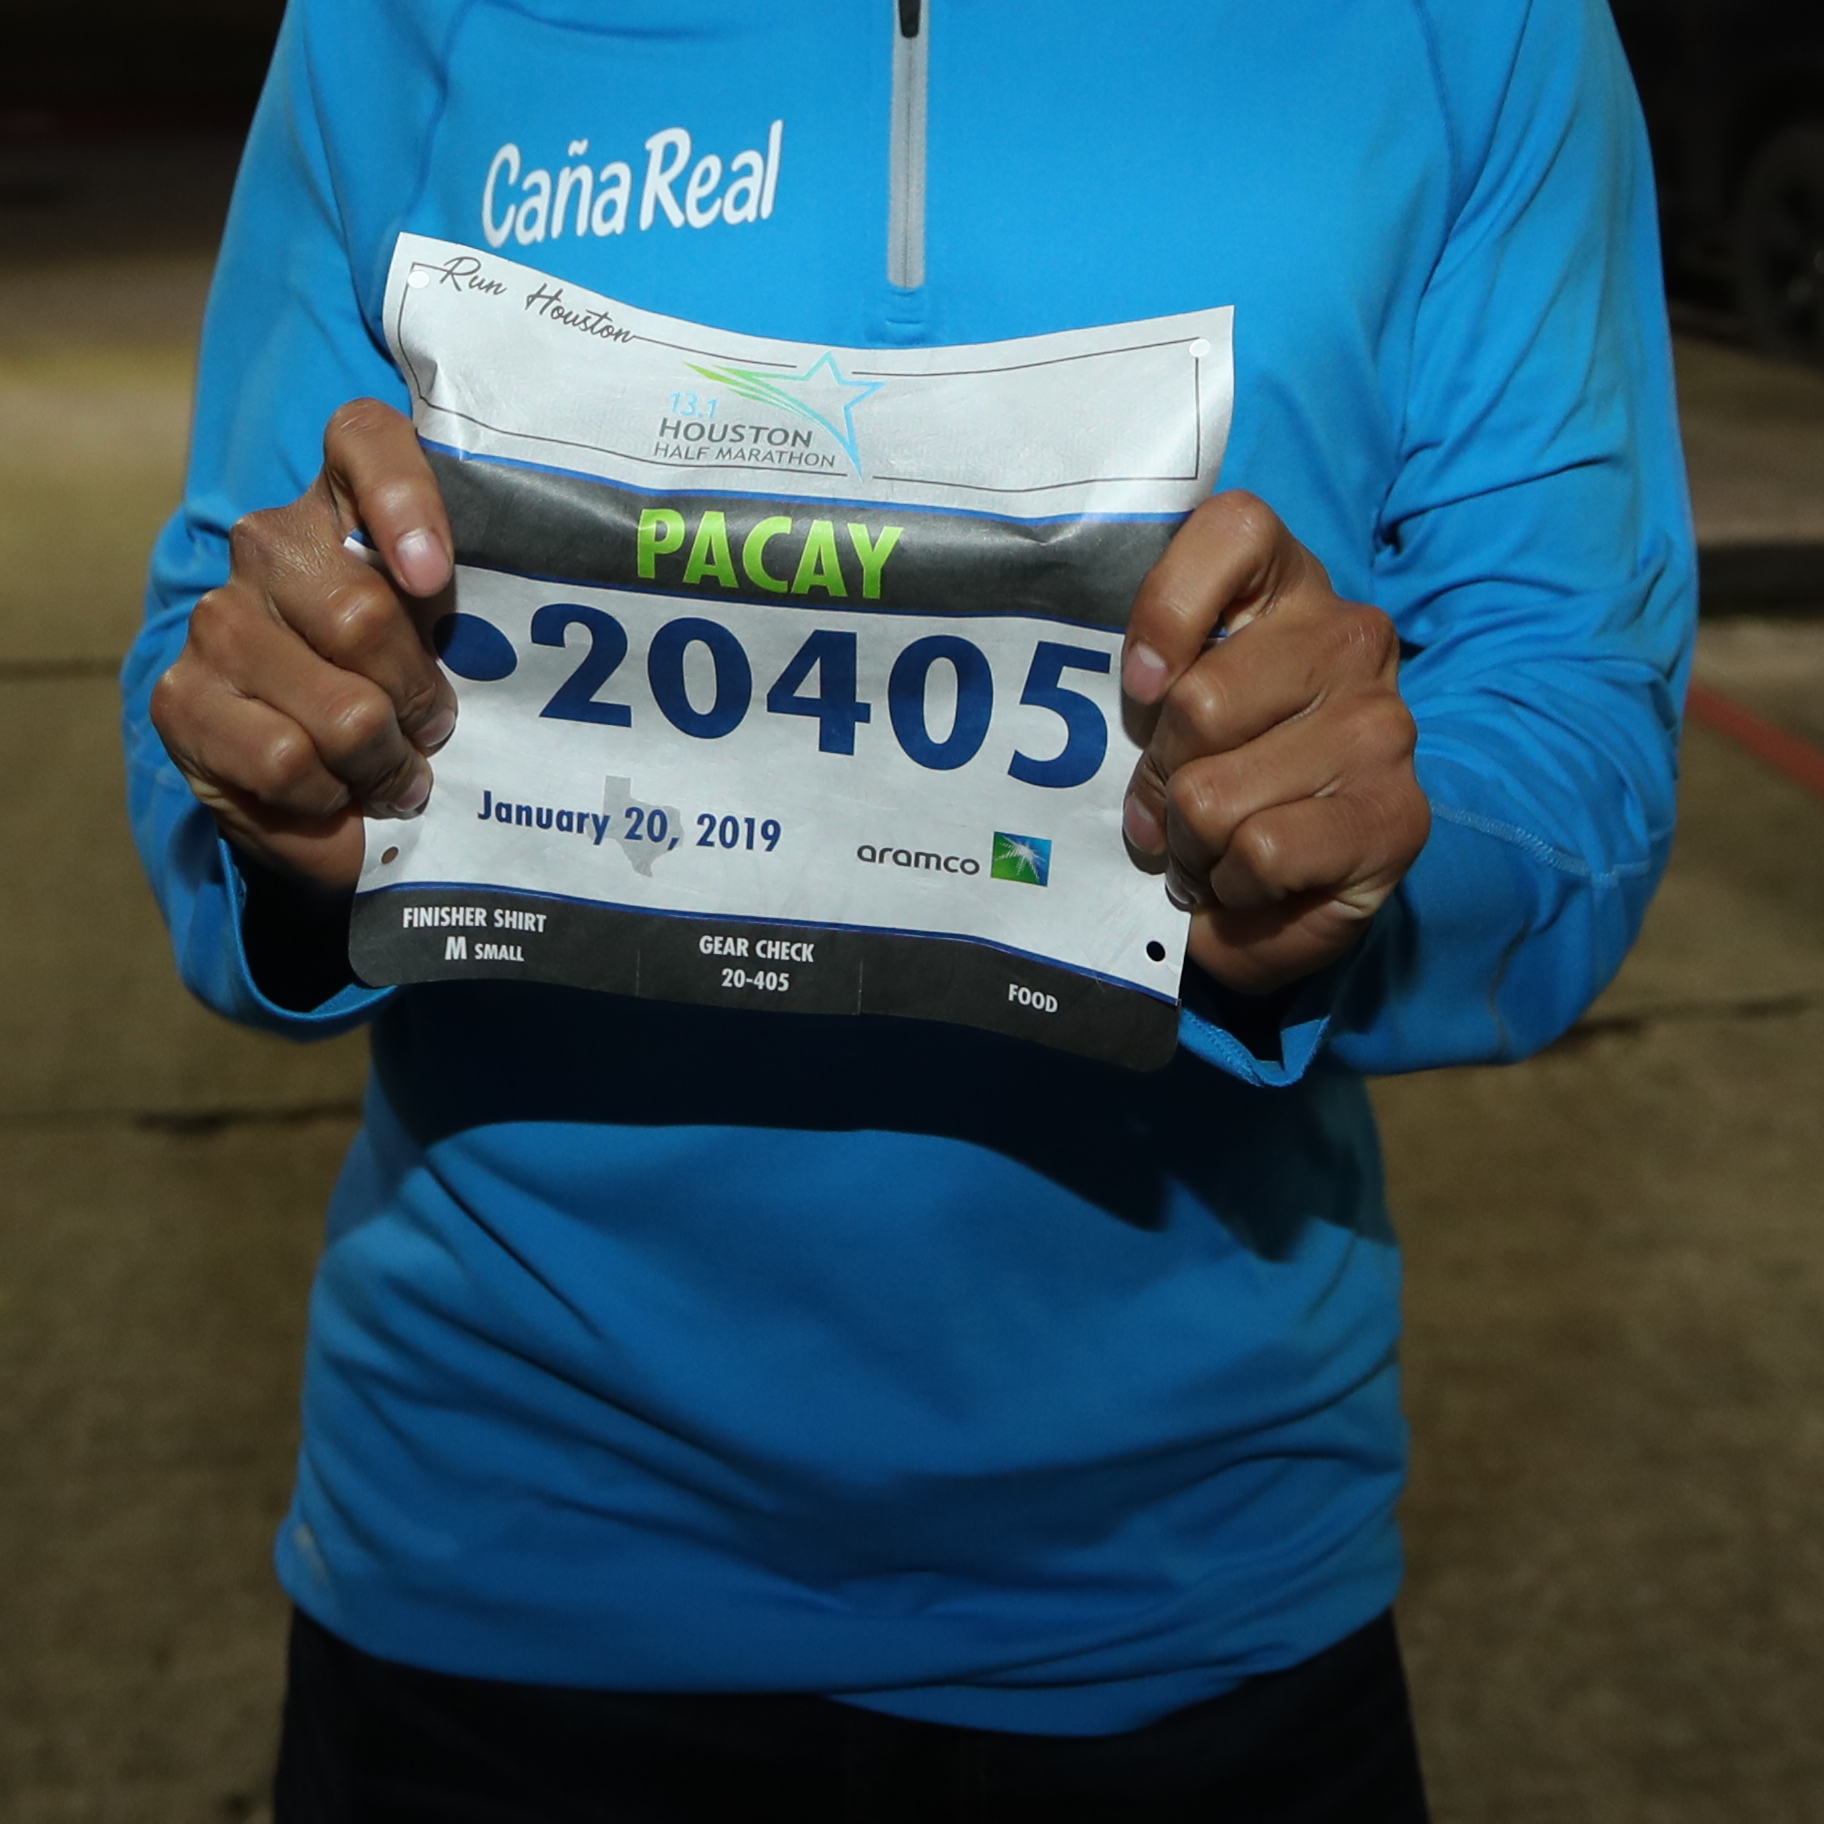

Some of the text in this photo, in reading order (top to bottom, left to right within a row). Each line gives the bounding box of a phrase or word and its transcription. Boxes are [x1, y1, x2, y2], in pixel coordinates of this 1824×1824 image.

[482, 119, 784, 248] Caña Real
[439, 256, 636, 344] Run Houston
[669, 391, 719, 418] 13.1
[658, 417, 813, 448] HOUSTON
[653, 441, 836, 468] HALF MARATHON
[637, 508, 905, 599] PACAY
[530, 603, 1112, 789] 20405
[477, 789, 783, 853] January 20, 2019
[857, 844, 980, 875] aramco
[402, 907, 547, 933] FINISHER SHIRT
[444, 936, 524, 962] M SMALL
[699, 935, 815, 963] GEAR CHECK
[721, 968, 790, 992] 20-405
[1008, 983, 1058, 1013] FOOD
